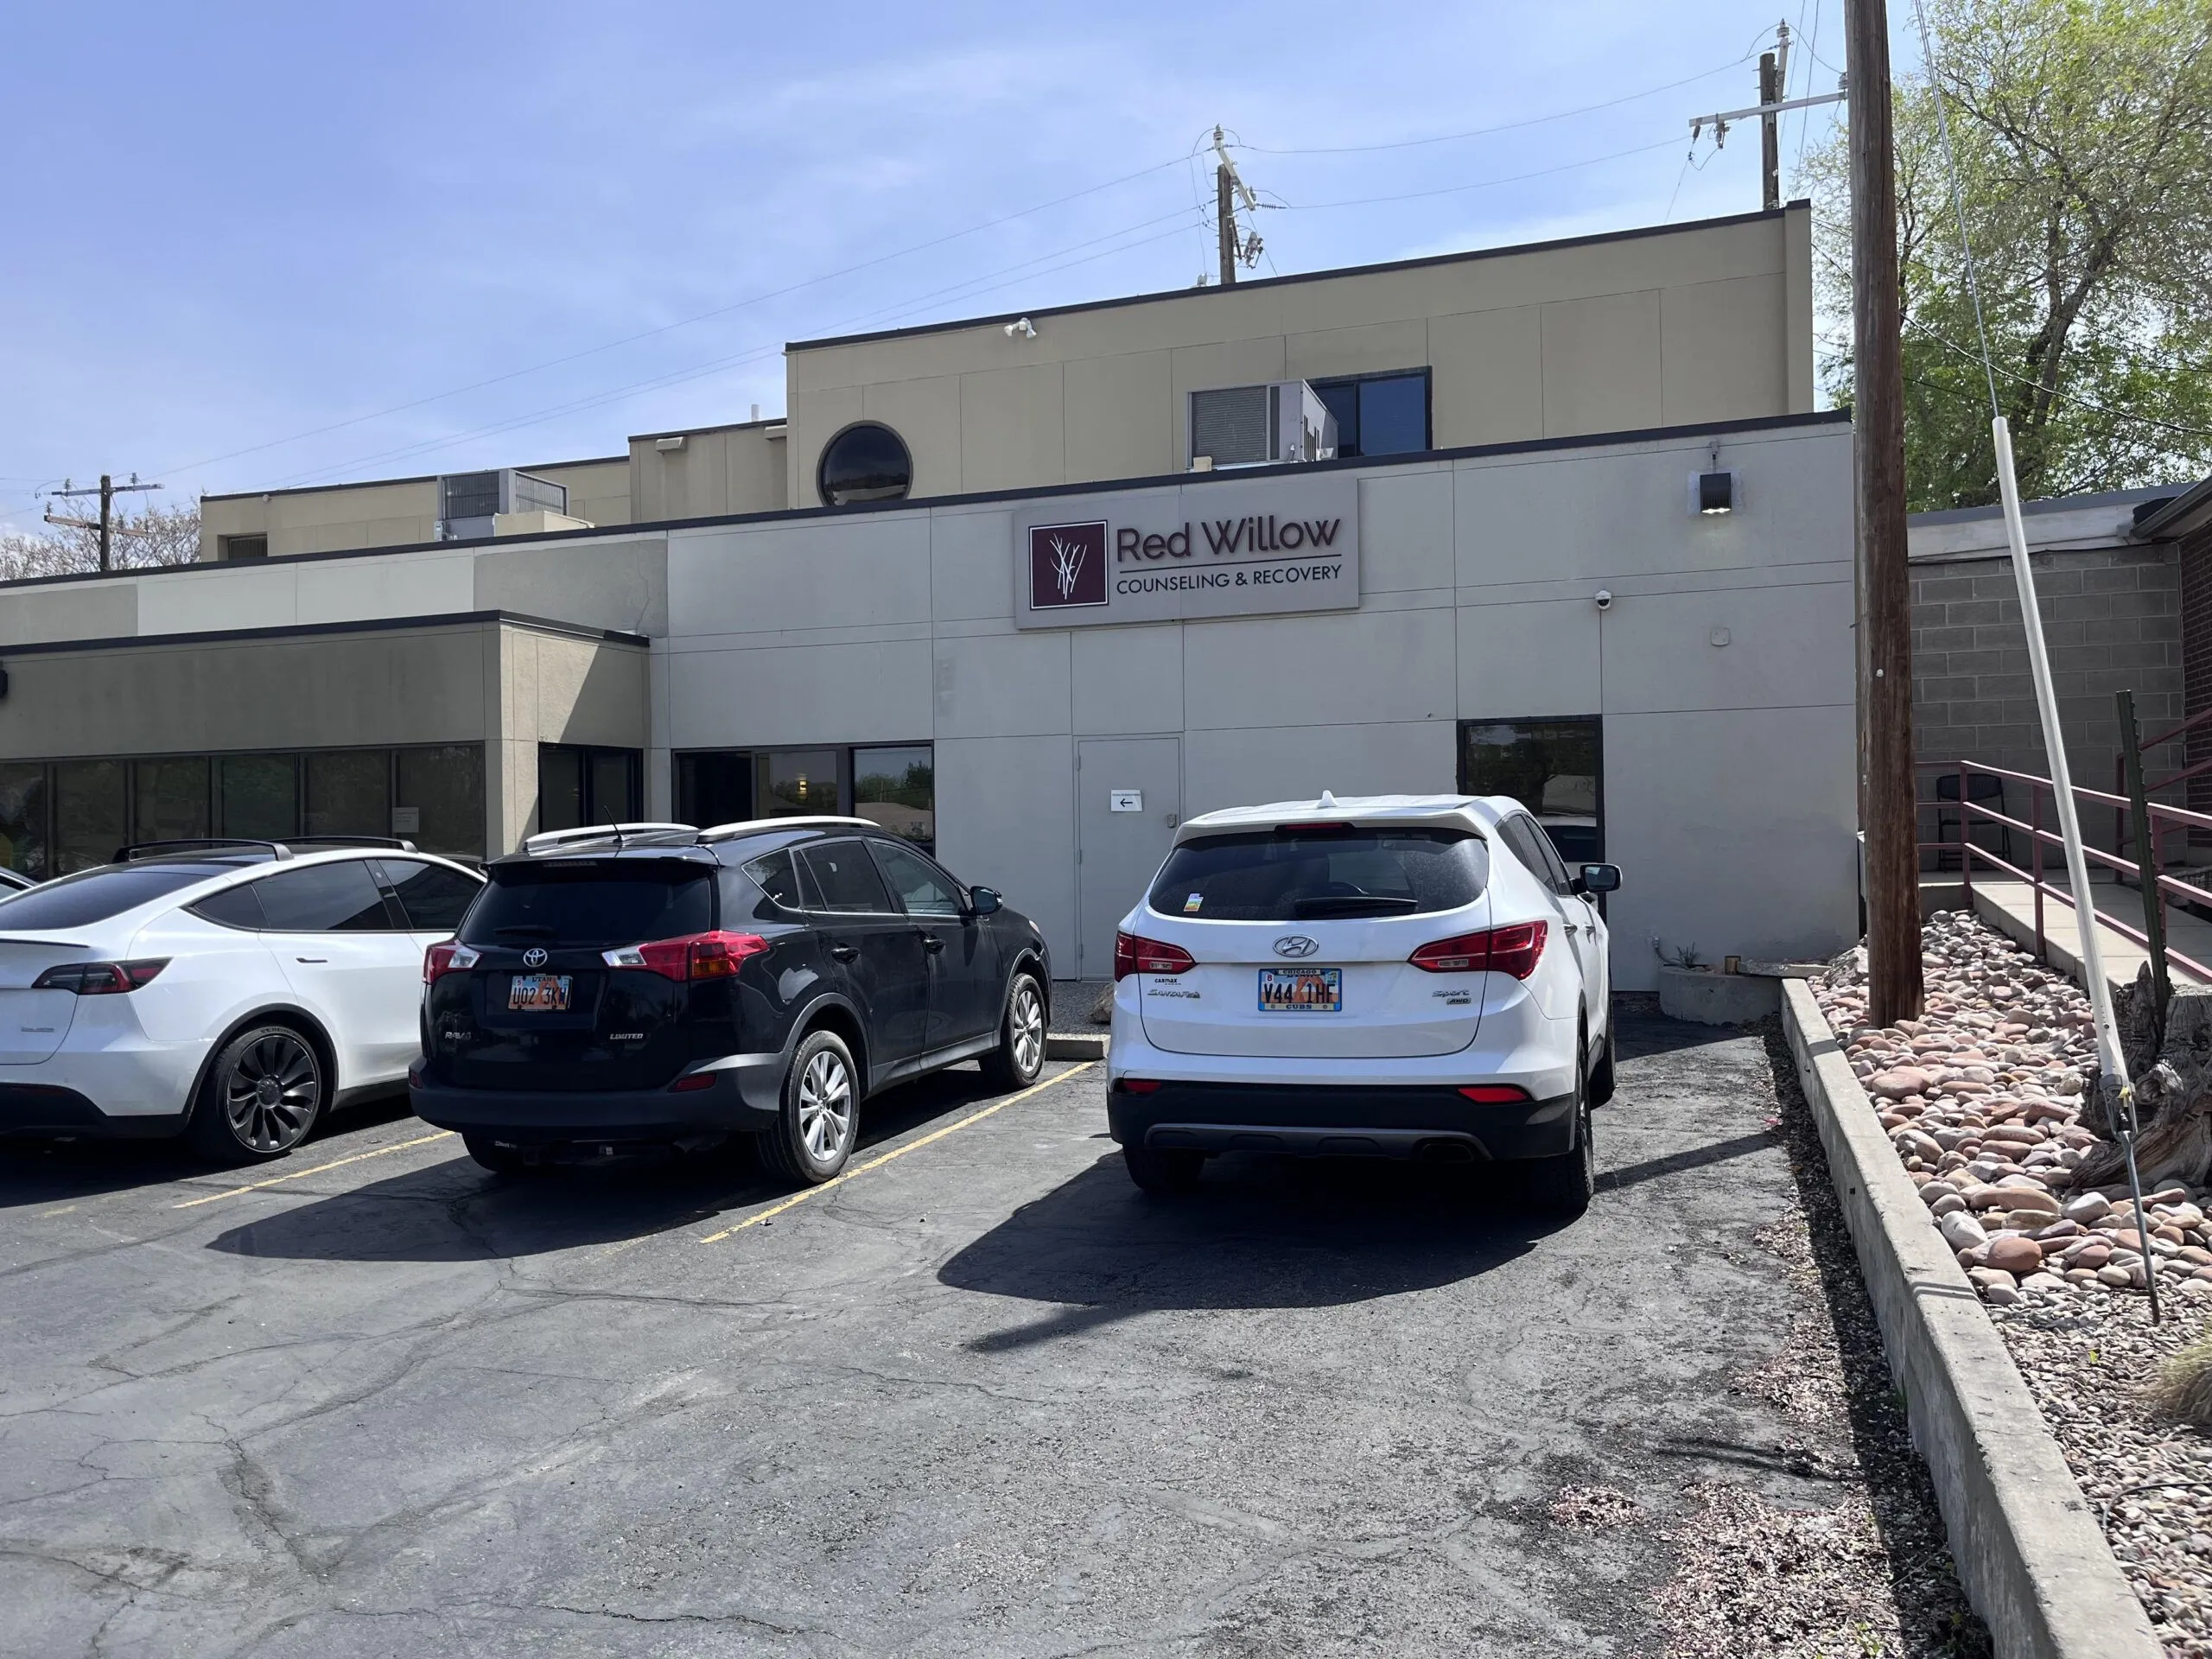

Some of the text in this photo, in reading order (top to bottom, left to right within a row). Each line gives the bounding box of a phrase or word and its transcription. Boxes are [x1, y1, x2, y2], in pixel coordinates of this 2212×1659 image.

[1116, 515, 1341, 563] Red Willow
[1116, 564, 1342, 595] COUNSELING & RECOVERY
[1263, 983, 1293, 1003] V44
